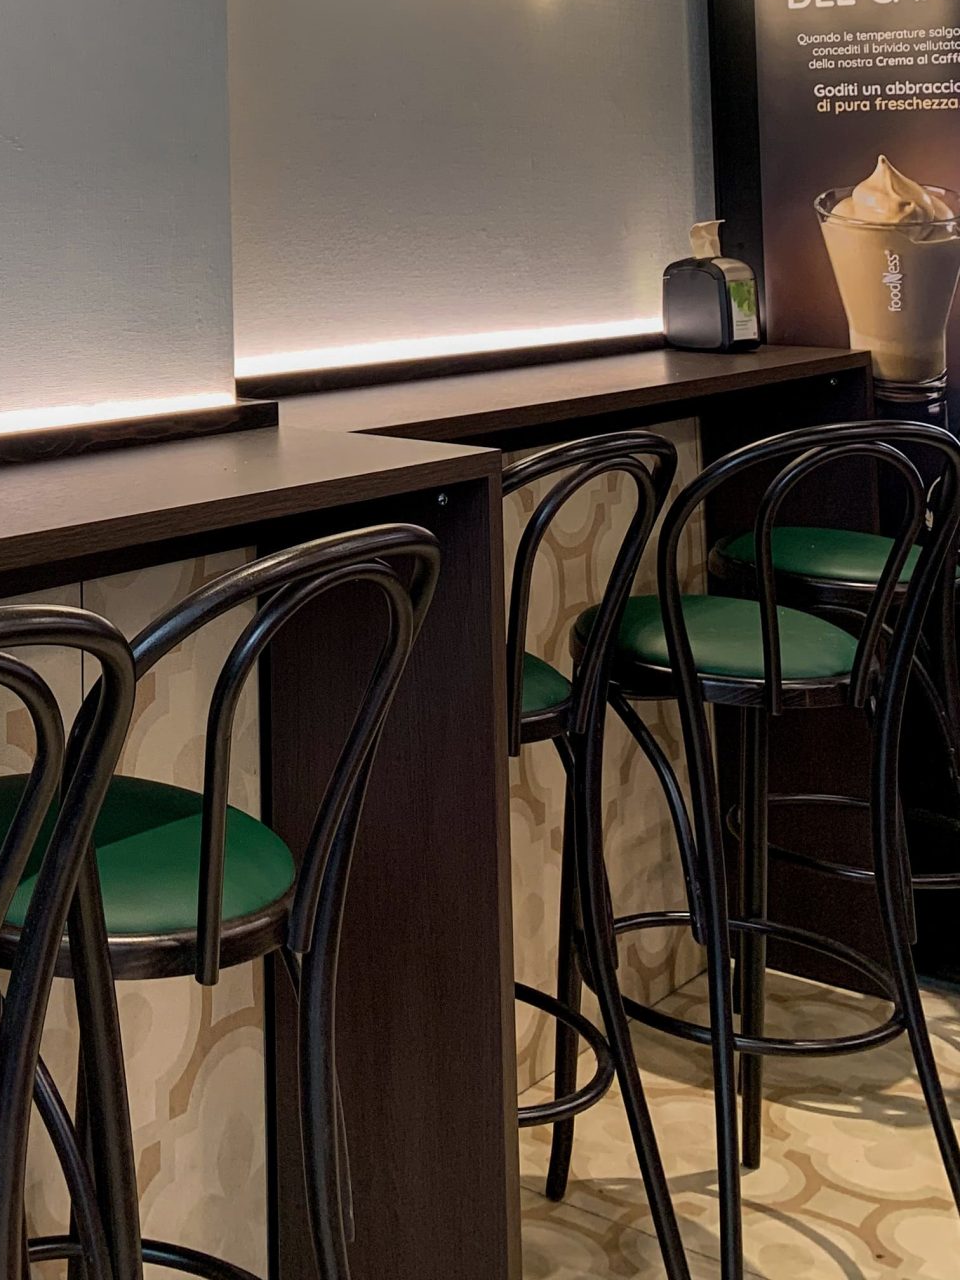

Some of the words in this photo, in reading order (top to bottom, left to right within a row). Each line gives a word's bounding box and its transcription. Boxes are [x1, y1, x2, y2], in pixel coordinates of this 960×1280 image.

[797, 32, 841, 45] Quando
[843, 31, 853, 41] le
[856, 29, 926, 42] temperature
[812, 44, 861, 56] concediti
[863, 43, 870, 54] il
[872, 42, 911, 54] brivido
[808, 58, 835, 69] della
[838, 58, 873, 68] nostra
[876, 55, 914, 67] Crema
[917, 54, 928, 65] al
[814, 82, 858, 97] Goditi
[862, 85, 881, 95] un
[817, 98, 830, 112] di
[835, 100, 870, 114] pura
